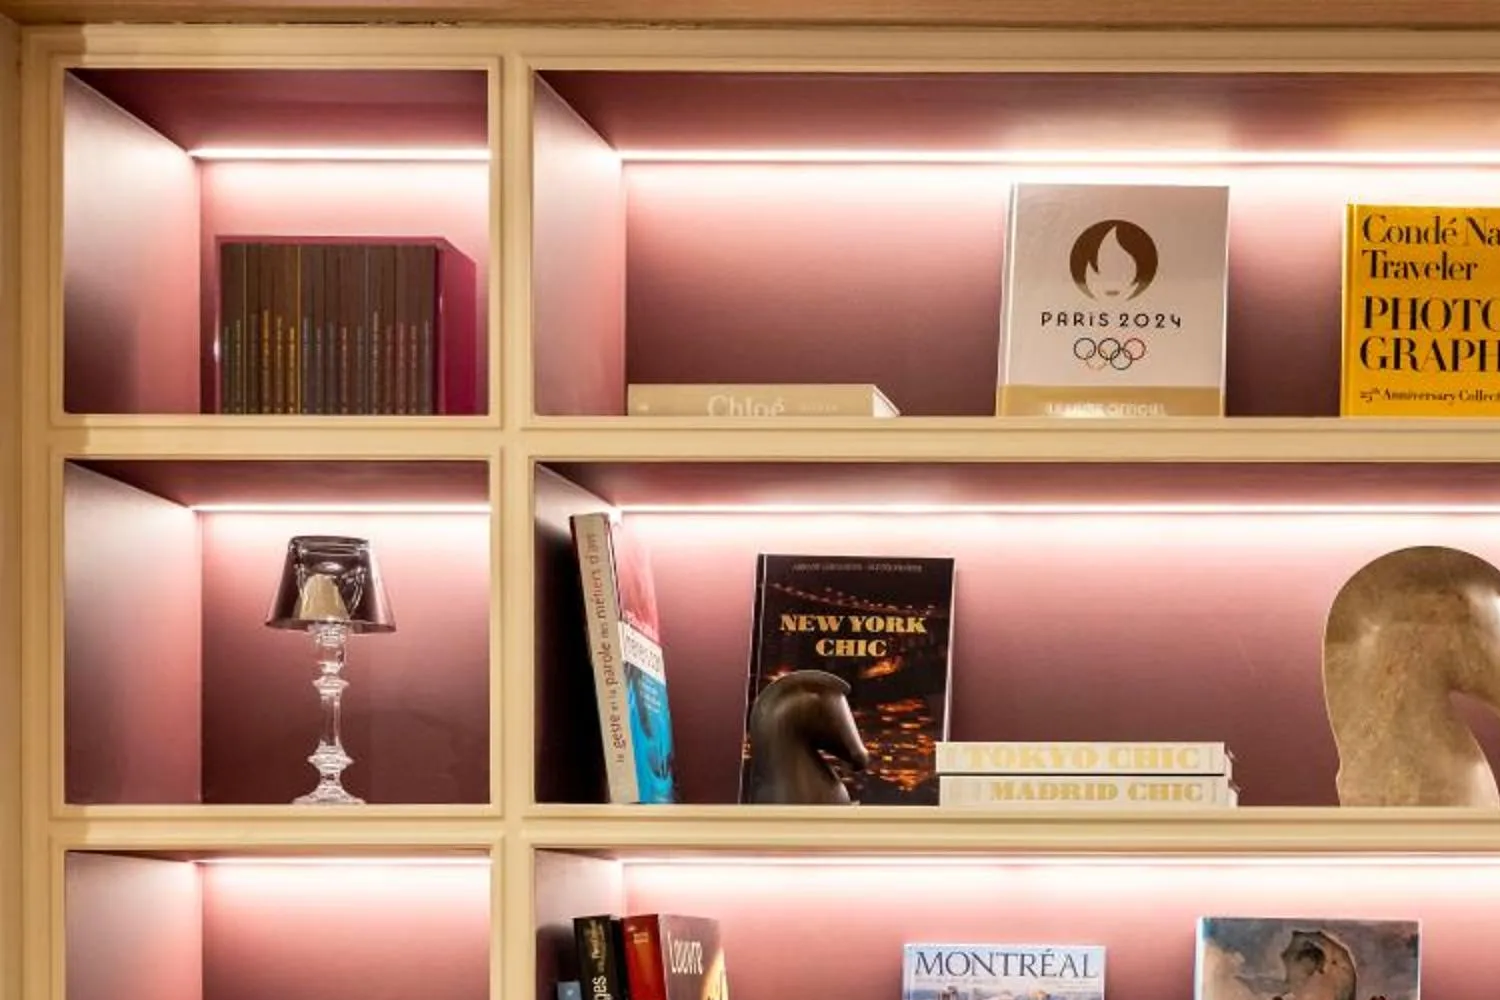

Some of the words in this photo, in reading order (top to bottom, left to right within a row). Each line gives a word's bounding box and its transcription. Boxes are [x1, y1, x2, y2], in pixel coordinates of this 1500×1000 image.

[1362, 214, 1457, 245] Condé
[1362, 249, 1478, 281] Traveler
[1041, 312, 1109, 327] PARIS
[1119, 313, 1181, 328] 2024
[707, 394, 784, 416] Chloé
[1384, 388, 1455, 406] Anniversary
[592, 569, 606, 622] métiers
[780, 614, 845, 632] NEW
[850, 616, 927, 634] YORK
[815, 639, 888, 657] CHIC
[598, 642, 620, 687] parole
[607, 714, 626, 749] geste
[968, 746, 1099, 770] TOKYO
[1107, 746, 1200, 769] CHIC
[991, 782, 1119, 801] MADRID
[1127, 783, 1202, 801] CHIC
[914, 948, 1099, 978] MONTRÉAL
